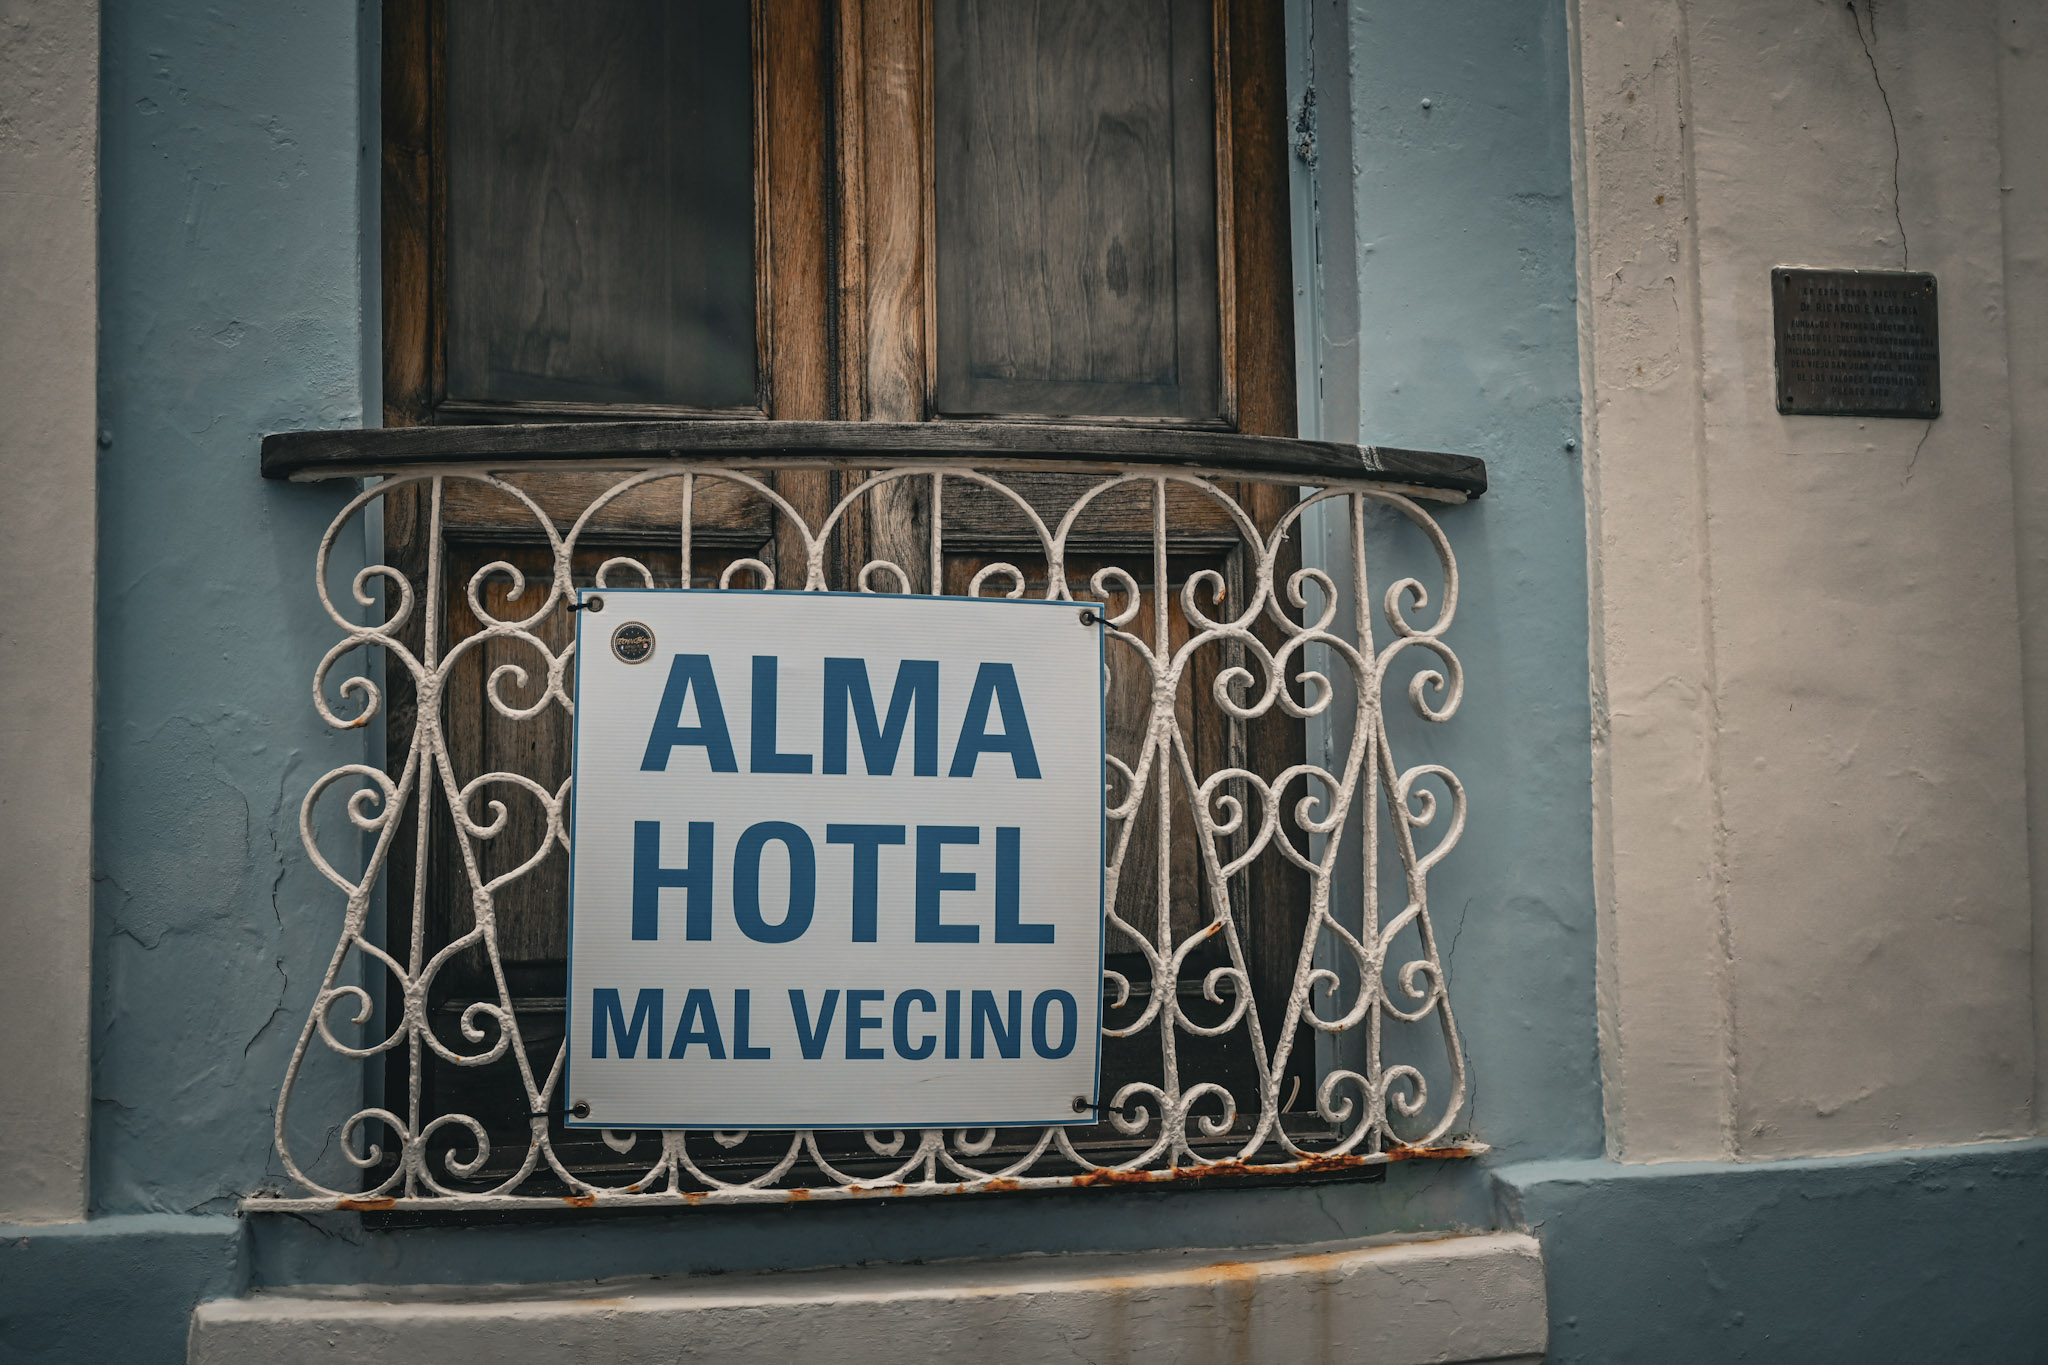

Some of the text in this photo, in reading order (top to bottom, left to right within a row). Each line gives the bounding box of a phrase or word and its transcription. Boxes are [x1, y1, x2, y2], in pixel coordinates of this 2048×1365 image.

[1816, 303, 1860, 313] RICARDO
[641, 655, 1042, 778] ALMA
[632, 820, 1054, 943] HOTEL
[592, 989, 1077, 1059] MAL VECINO
